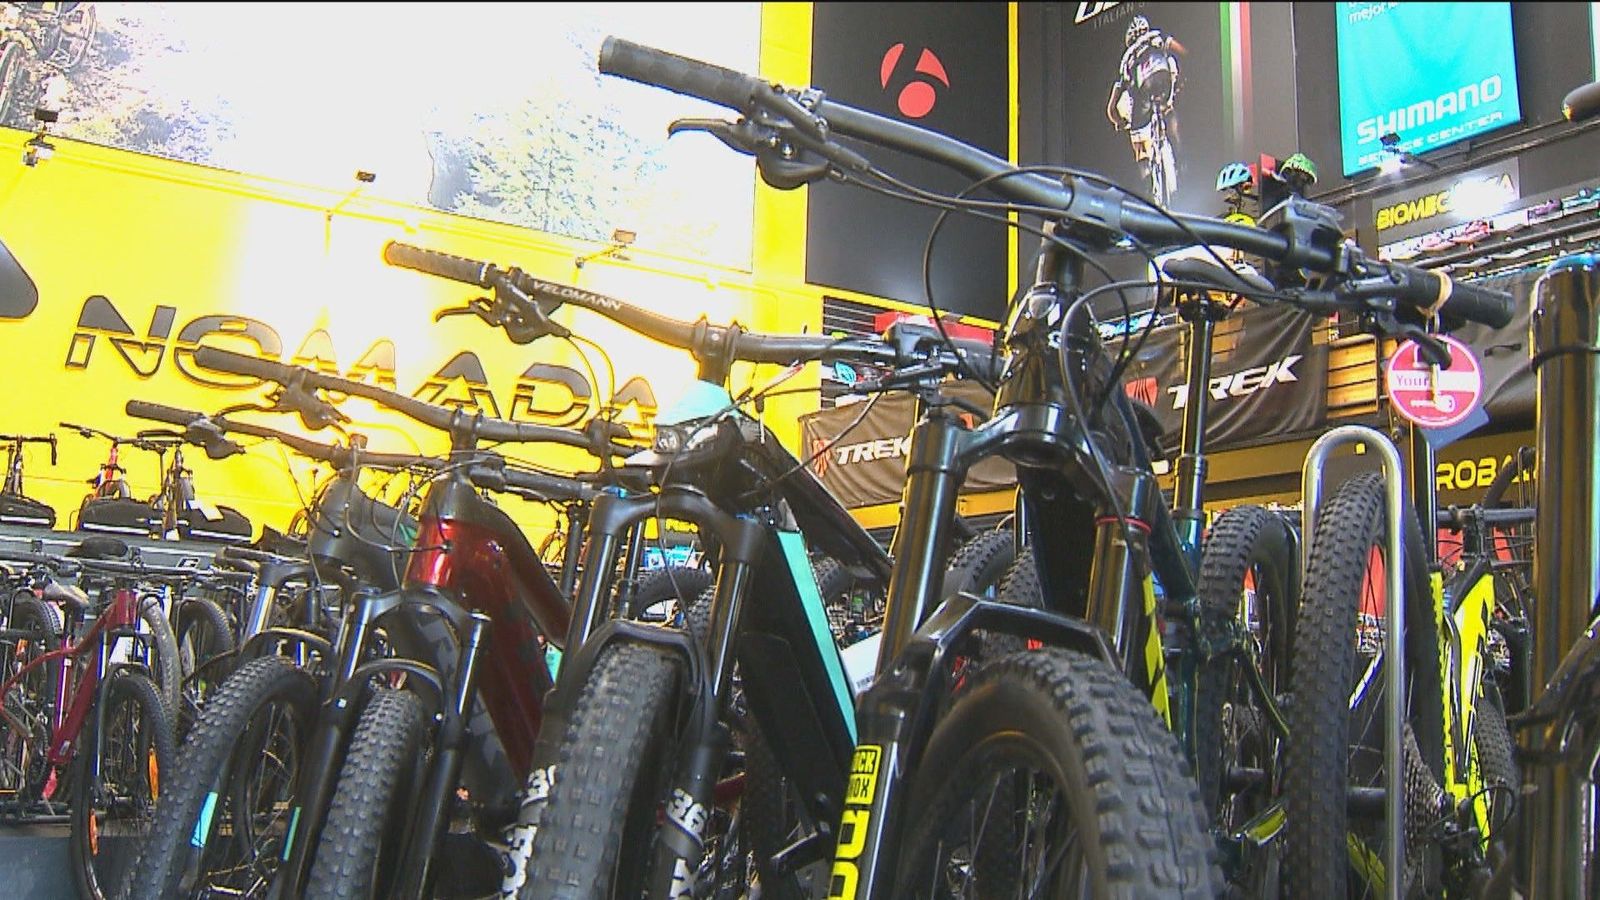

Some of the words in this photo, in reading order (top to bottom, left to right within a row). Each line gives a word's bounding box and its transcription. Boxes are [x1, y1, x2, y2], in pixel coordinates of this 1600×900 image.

[1356, 73, 1503, 146] SHIMANO
[1426, 111, 1504, 144] CENTER
[533, 280, 622, 312] VELOMANN
[65, 294, 659, 446] NOMADA
[1168, 354, 1304, 411] TREK
[836, 436, 913, 465] TREK
[666, 787, 708, 836] 36
